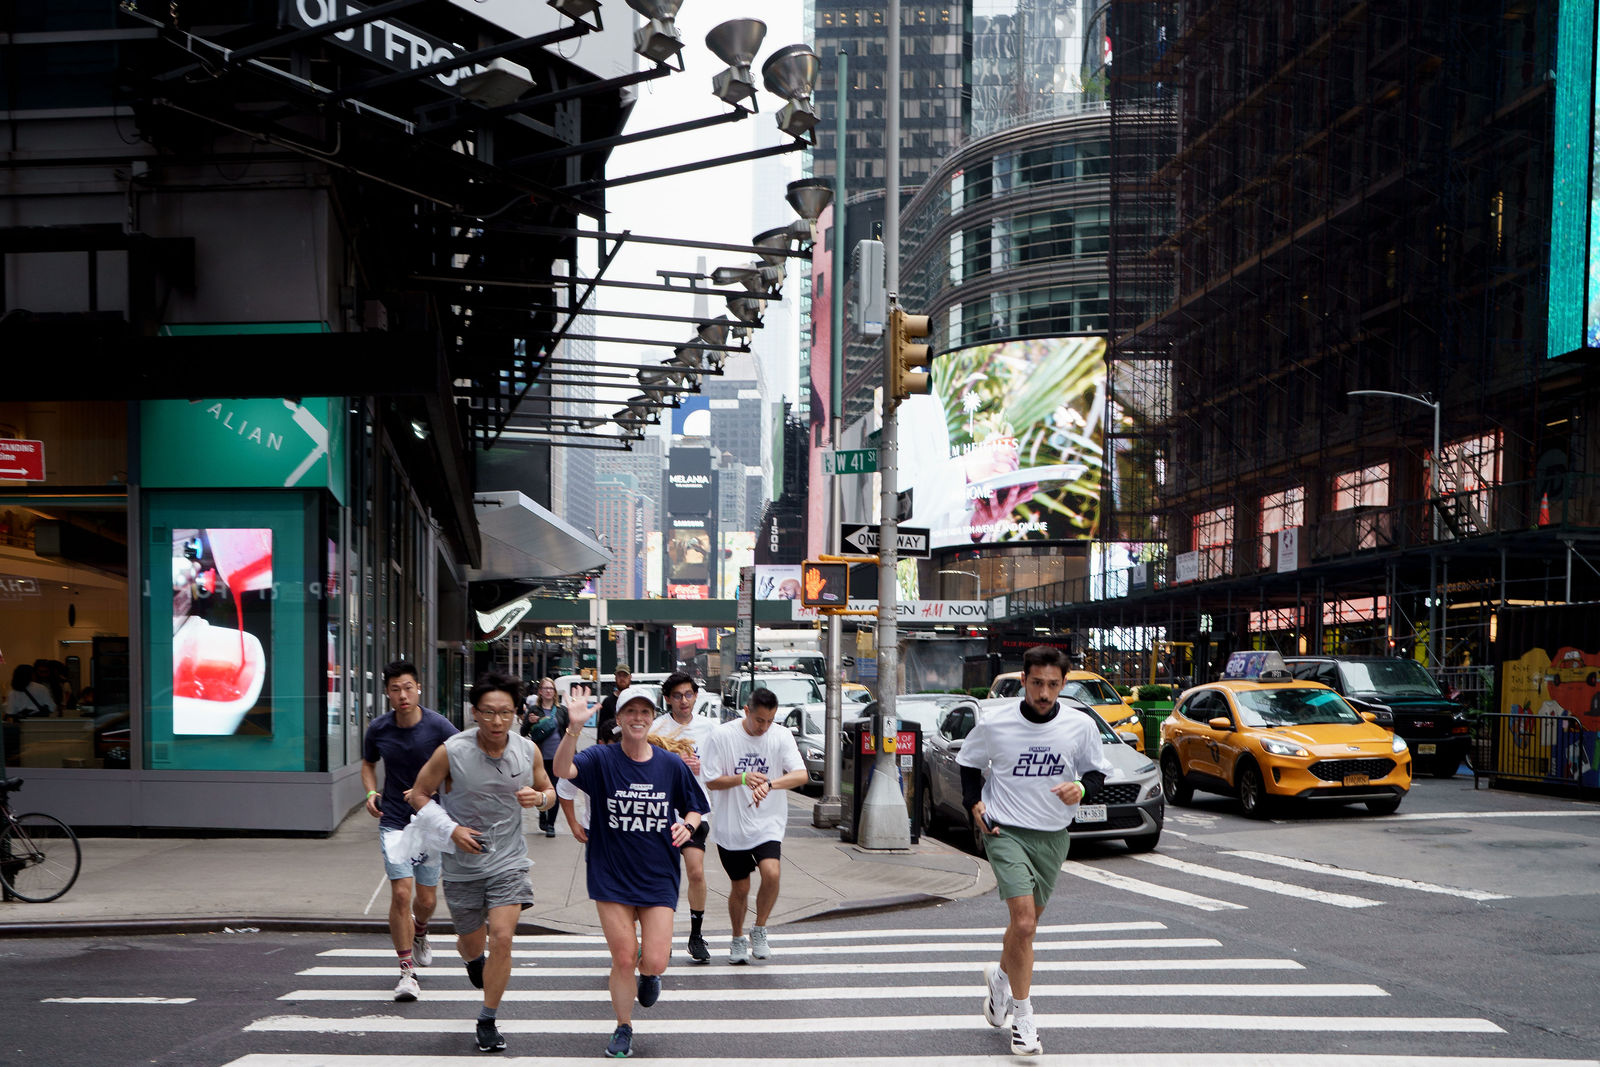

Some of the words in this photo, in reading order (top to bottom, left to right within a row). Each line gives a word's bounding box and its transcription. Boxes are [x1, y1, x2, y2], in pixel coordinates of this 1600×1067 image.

[837, 454, 846, 471] W
[850, 453, 863, 471] 41
[868, 450, 876, 461] St
[669, 474, 709, 484] MELANIA
[1018, 521, 1048, 531] ONLINE
[770, 517, 779, 552] 1500
[922, 602, 942, 617] H&M
[948, 604, 989, 616] NOW
[738, 757, 767, 767] RUN
[1018, 753, 1061, 765] RUN
[1012, 764, 1065, 777] CLUB
[615, 790, 638, 799] RUN
[638, 791, 666, 799] CLUB
[607, 798, 669, 816] EVENT
[608, 814, 668, 832] STAFF
